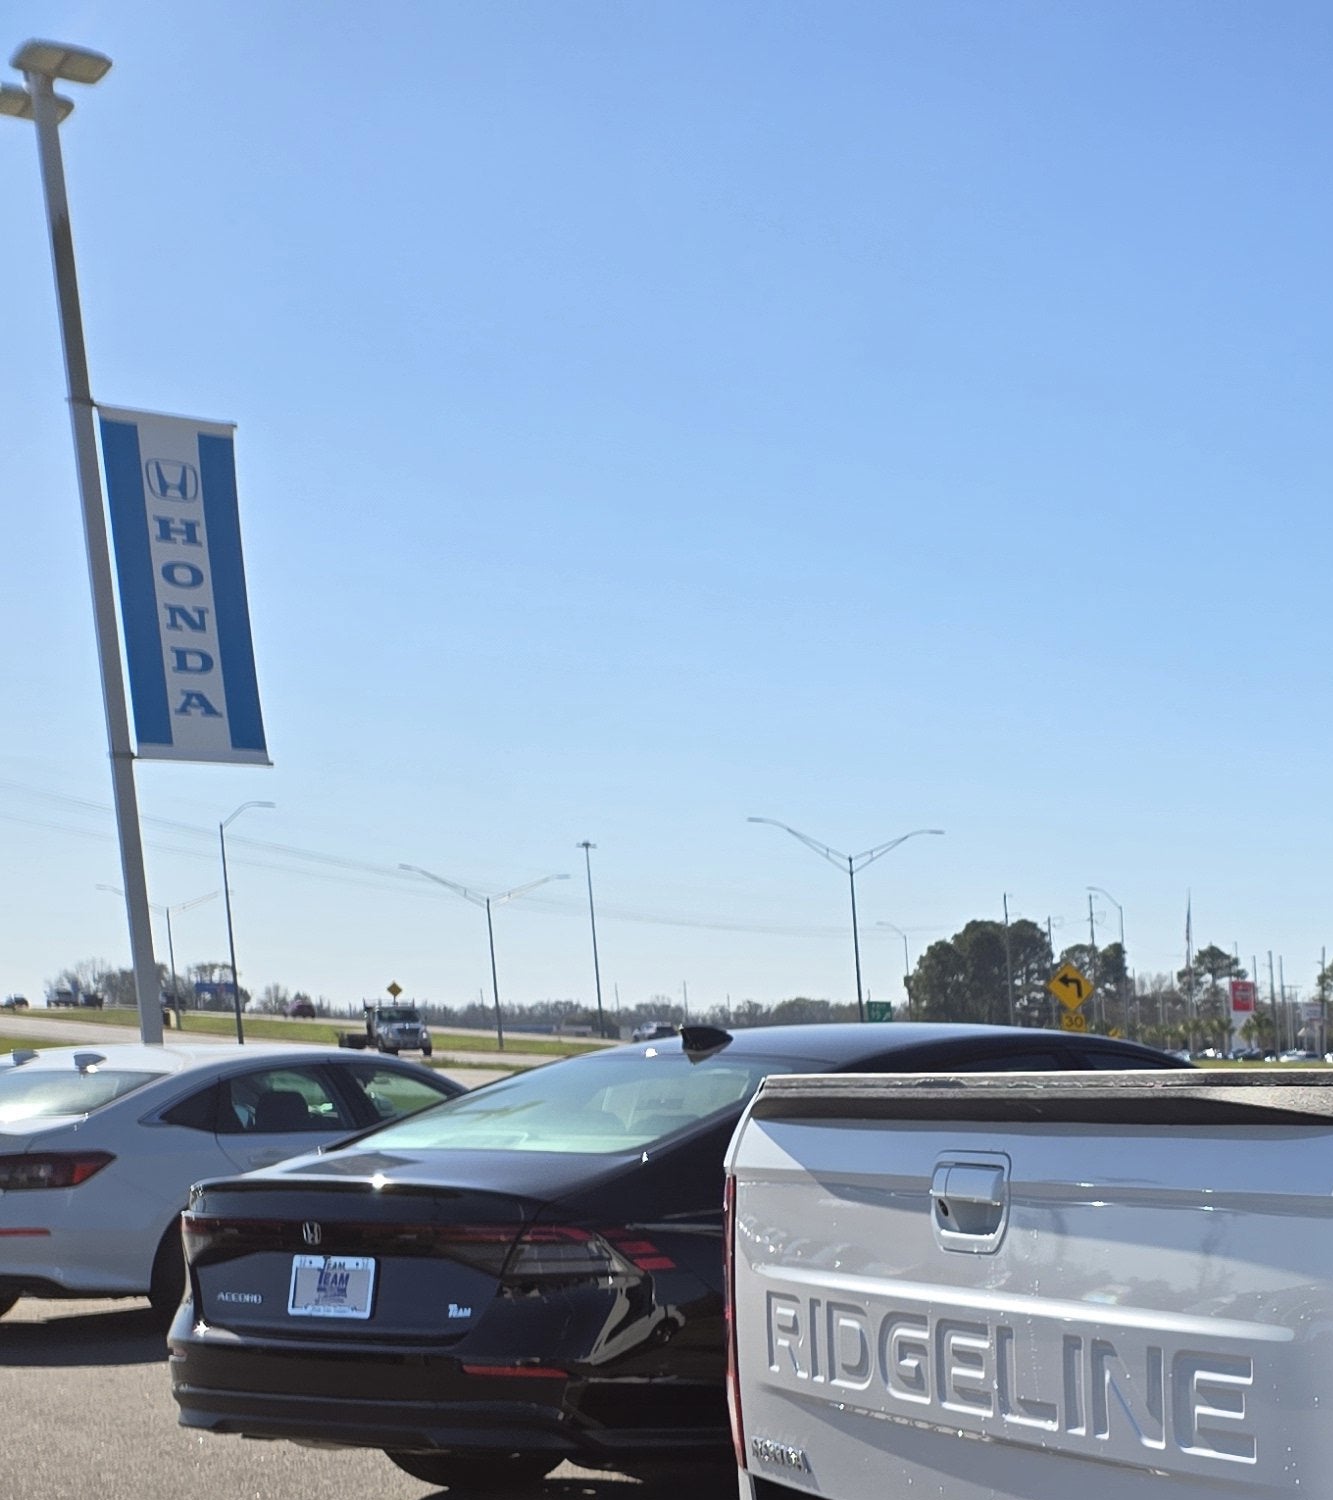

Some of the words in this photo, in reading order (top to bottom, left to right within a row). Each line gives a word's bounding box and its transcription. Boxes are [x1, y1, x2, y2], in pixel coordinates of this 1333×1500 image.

[152, 514, 223, 718] HONDA
[1064, 1015, 1084, 1028] 30
[318, 1269, 350, 1288] TEAM
[217, 1291, 262, 1304] ACCORD
[448, 1303, 471, 1318] TEAM
[766, 1289, 1257, 1464] RIDGELINE
